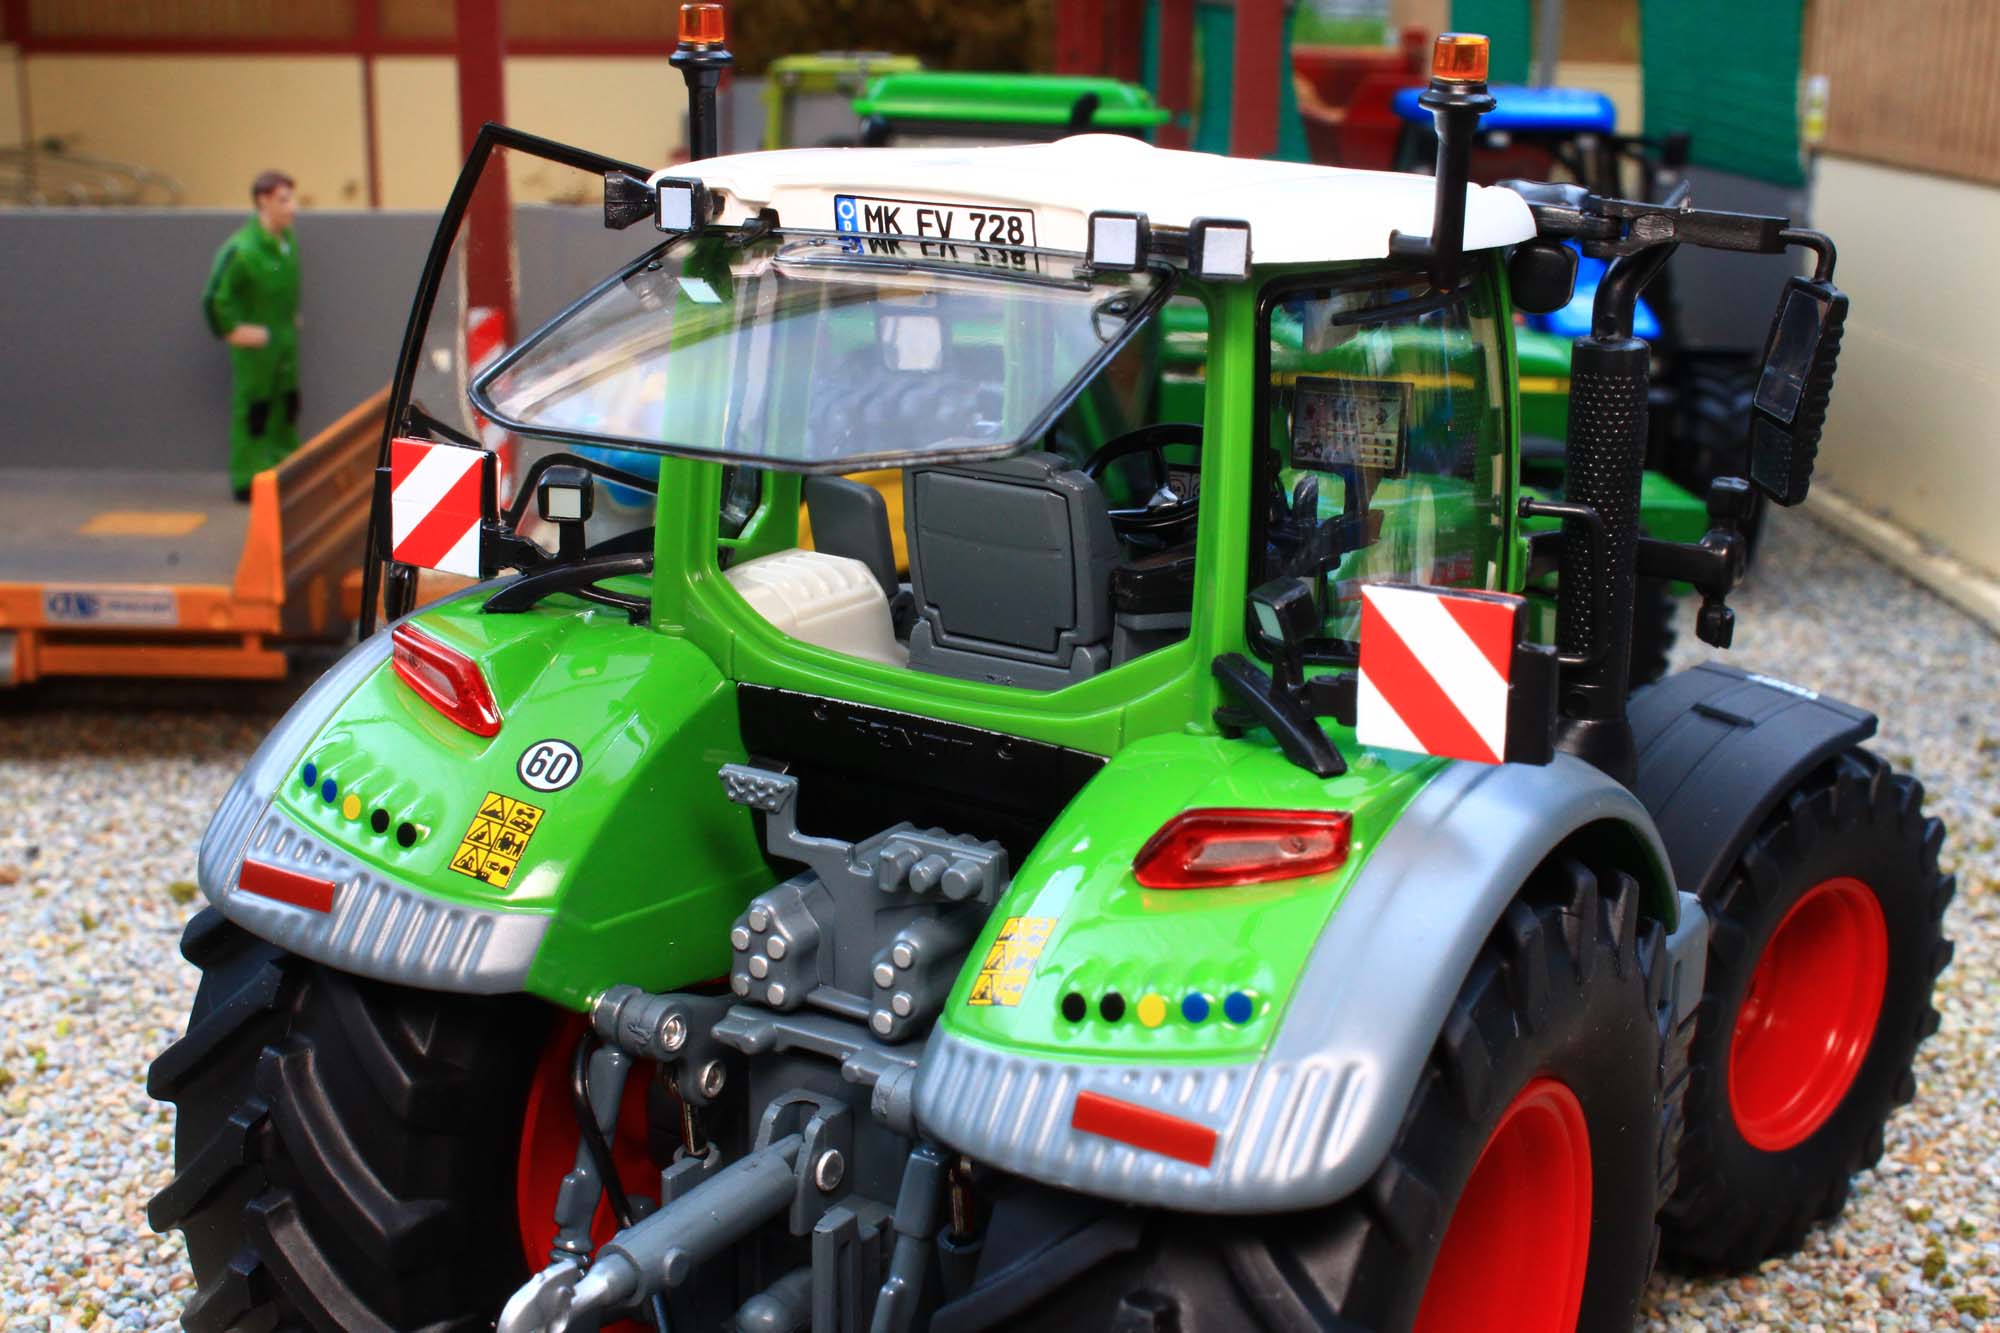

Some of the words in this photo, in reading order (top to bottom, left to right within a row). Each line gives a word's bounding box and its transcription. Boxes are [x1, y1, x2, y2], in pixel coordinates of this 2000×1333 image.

[865, 204, 902, 234] MK
[969, 213, 1025, 246] 728
[526, 746, 573, 784] 60
